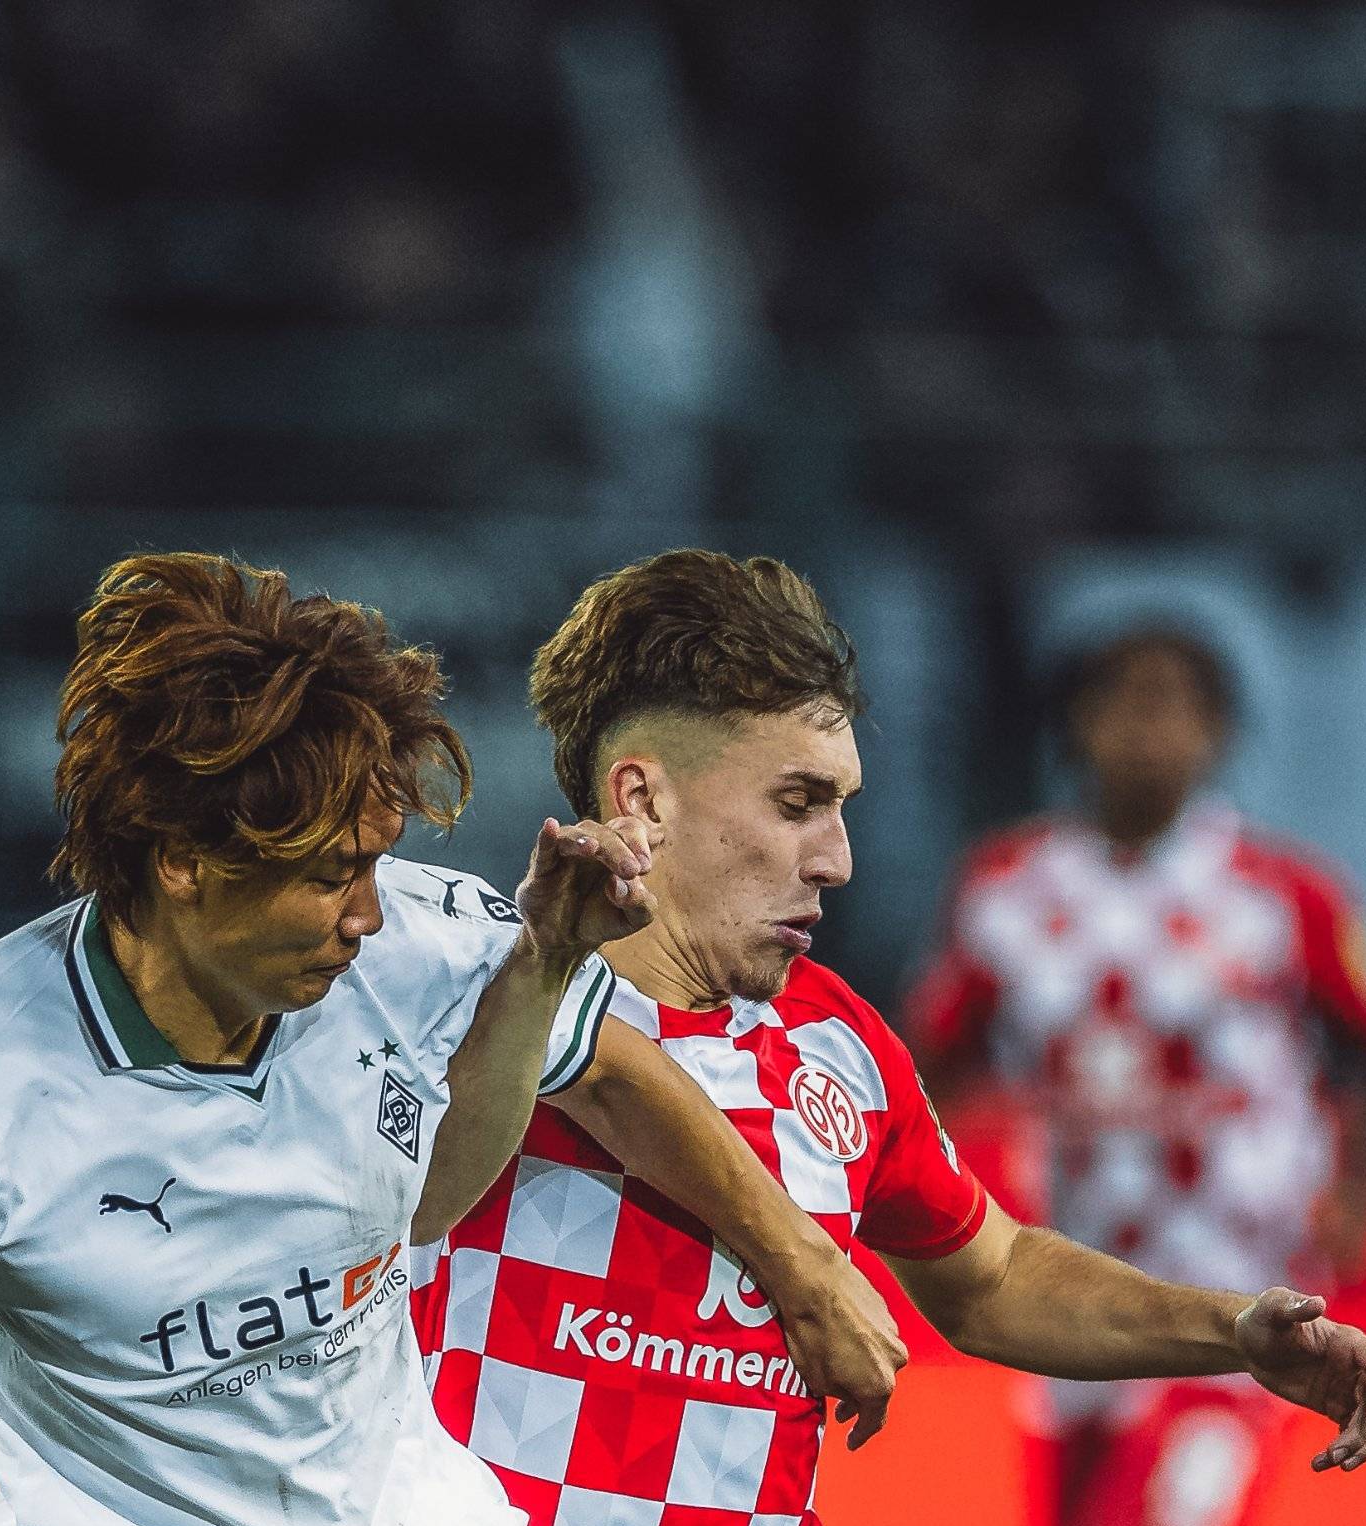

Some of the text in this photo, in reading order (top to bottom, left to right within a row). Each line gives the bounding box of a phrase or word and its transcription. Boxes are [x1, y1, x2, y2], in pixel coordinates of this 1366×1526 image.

[165, 1360, 272, 1406] Anlegen
[277, 1348, 318, 1371] bei
[324, 1318, 355, 1358] den
